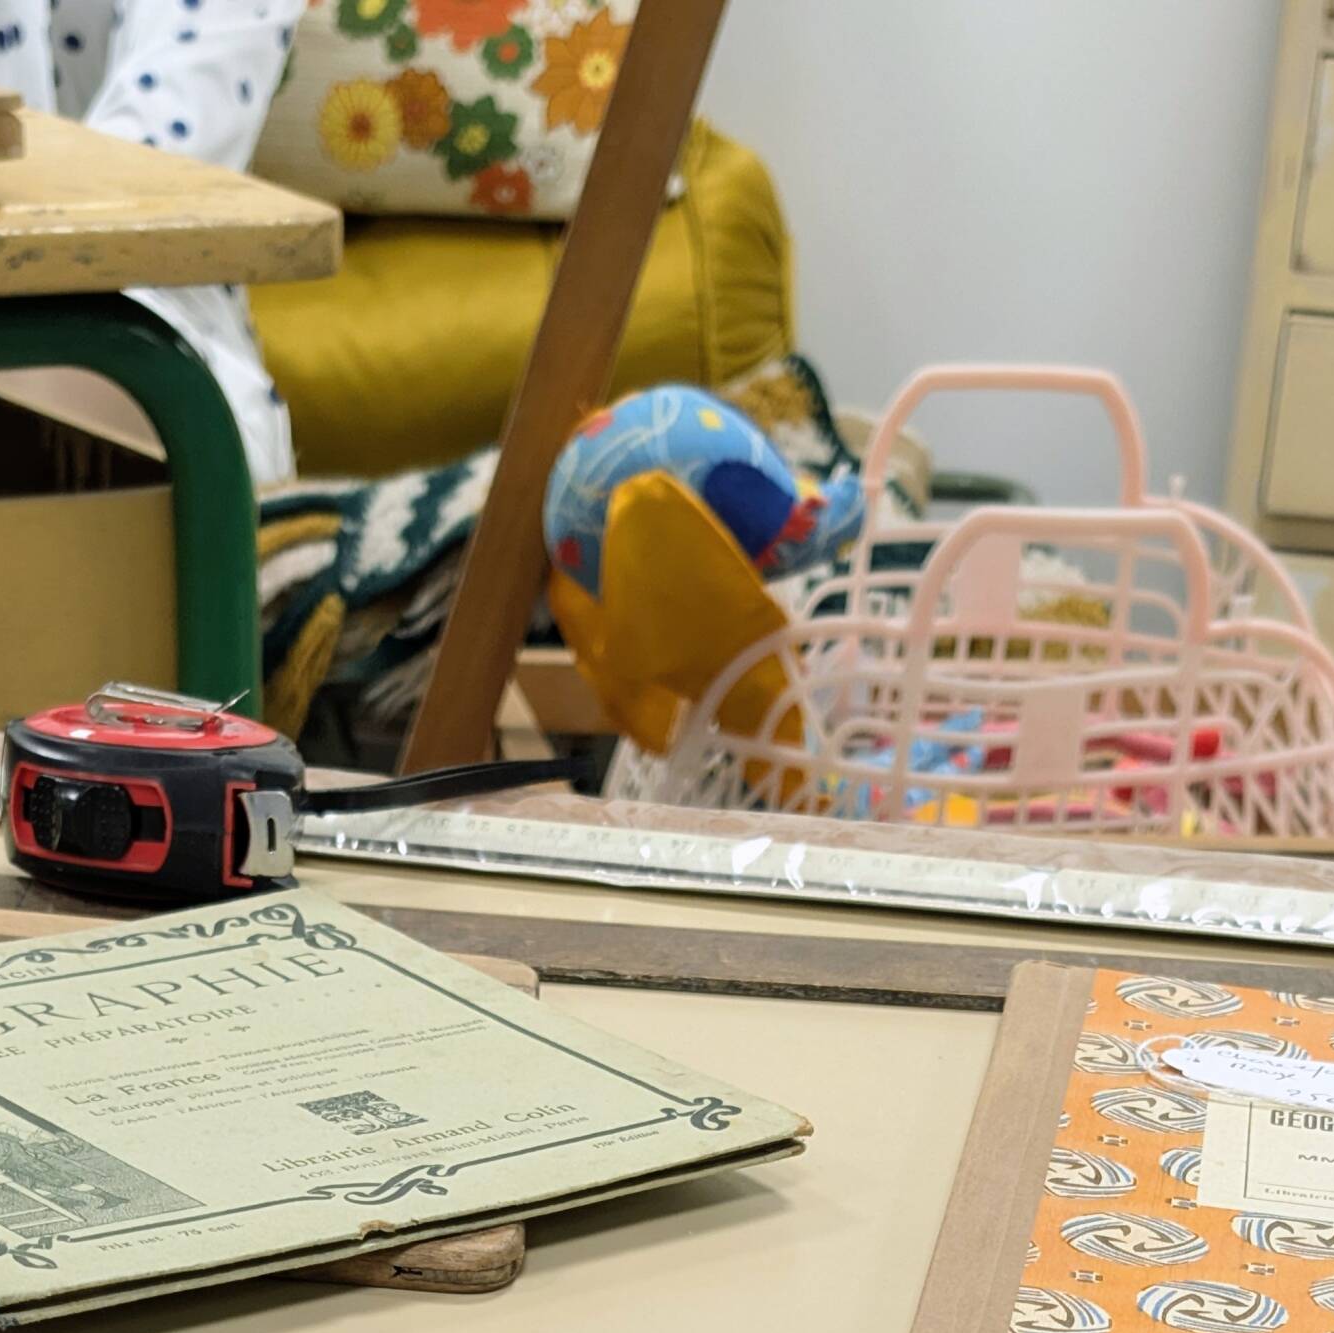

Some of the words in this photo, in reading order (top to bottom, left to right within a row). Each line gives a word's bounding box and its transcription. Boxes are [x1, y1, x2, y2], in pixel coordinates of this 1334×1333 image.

[44, 1004, 256, 1048] PRÉPARATOIRE
[63, 1092, 109, 1105] La
[116, 1072, 221, 1096] France
[88, 1096, 176, 1117] L'Europe
[541, 1115, 589, 1130] Paris
[261, 1145, 376, 1172] Librairie
[392, 1119, 493, 1149] Armand
[503, 1103, 577, 1123] Colin
[98, 1241, 133, 1253] Prix
